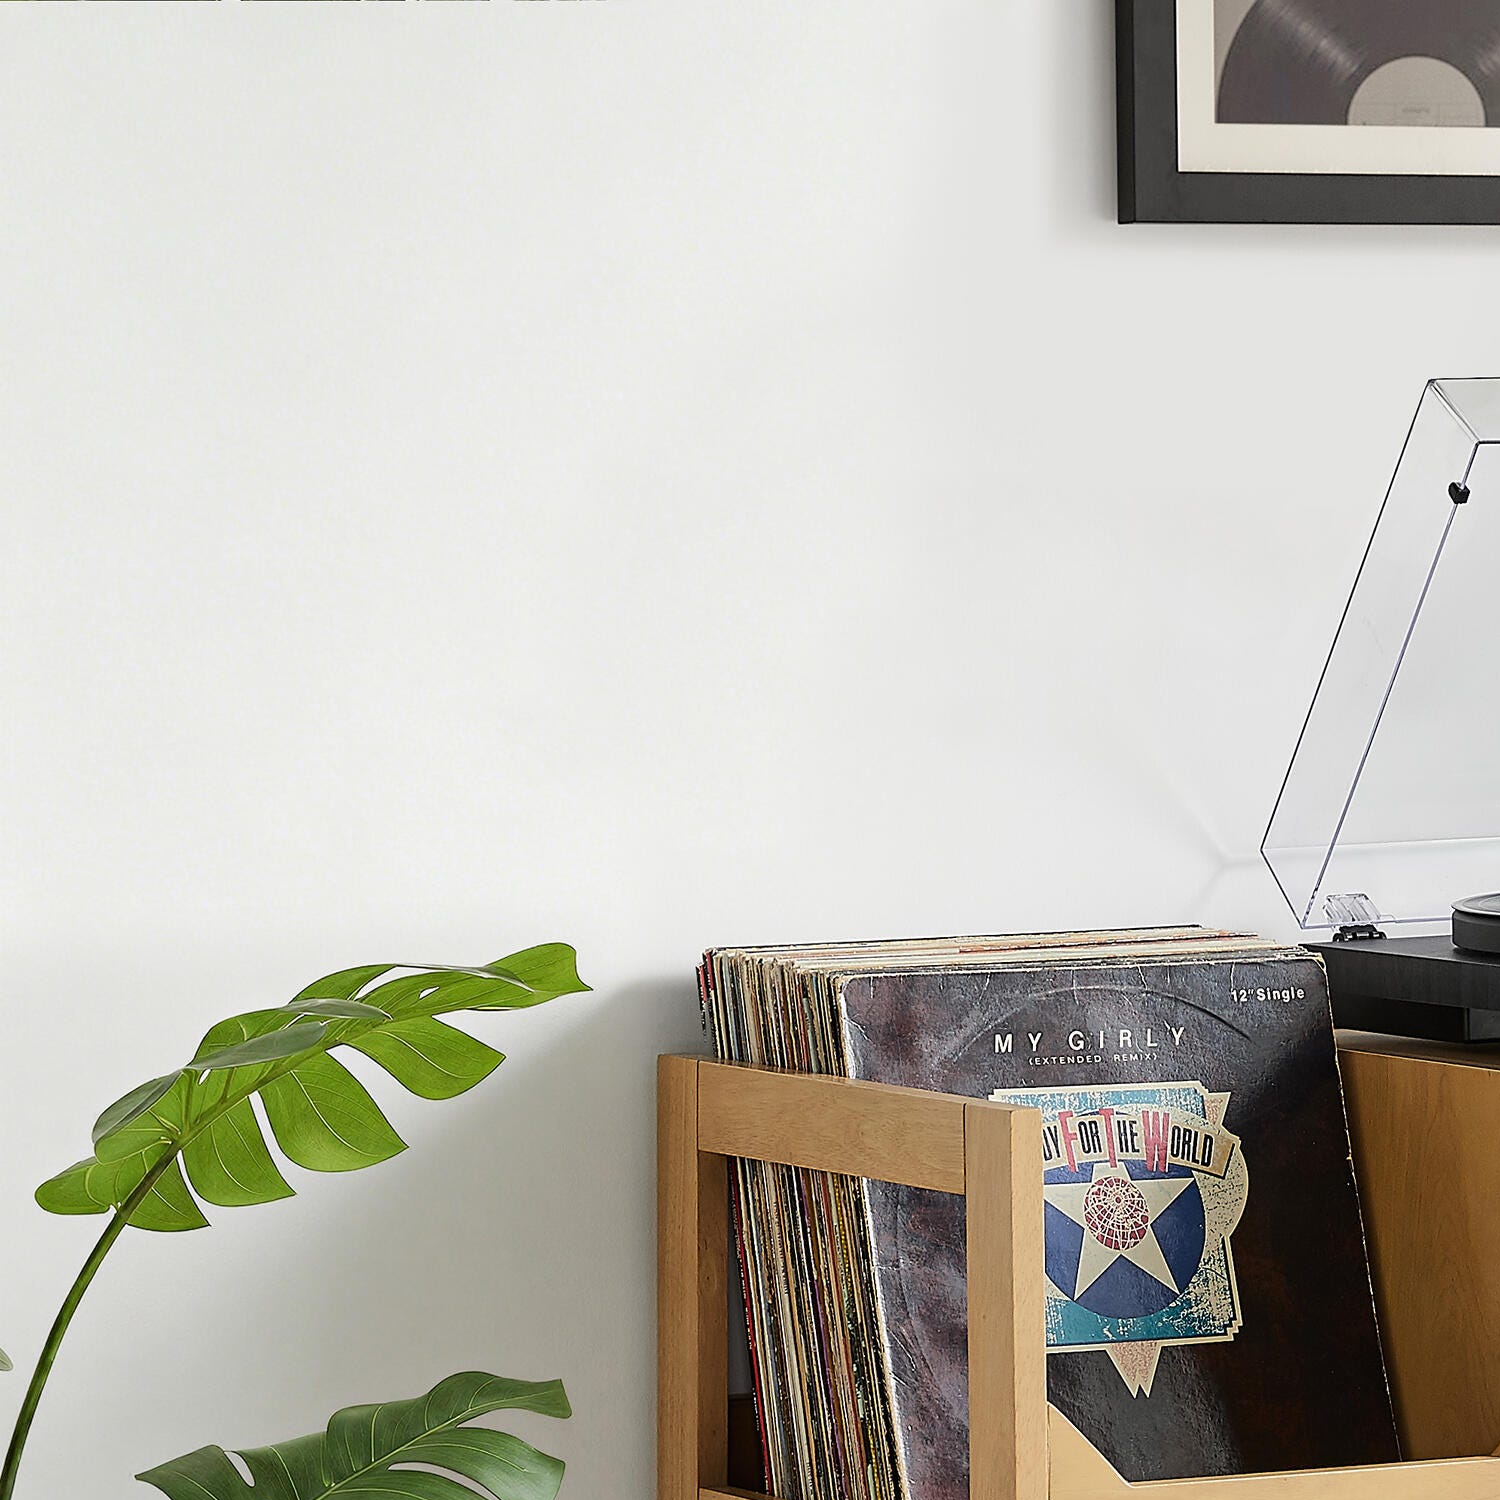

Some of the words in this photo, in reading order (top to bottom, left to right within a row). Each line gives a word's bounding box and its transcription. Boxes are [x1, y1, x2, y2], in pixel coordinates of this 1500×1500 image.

[1256, 986, 1305, 1003] Single
[994, 1032, 1042, 1053] MY
[1068, 1026, 1185, 1051] GIRLY
[1028, 1055, 1102, 1066] (EXTENDED
[1113, 1053, 1158, 1063] REMIX)
[1142, 1110, 1214, 1173] WORLD
